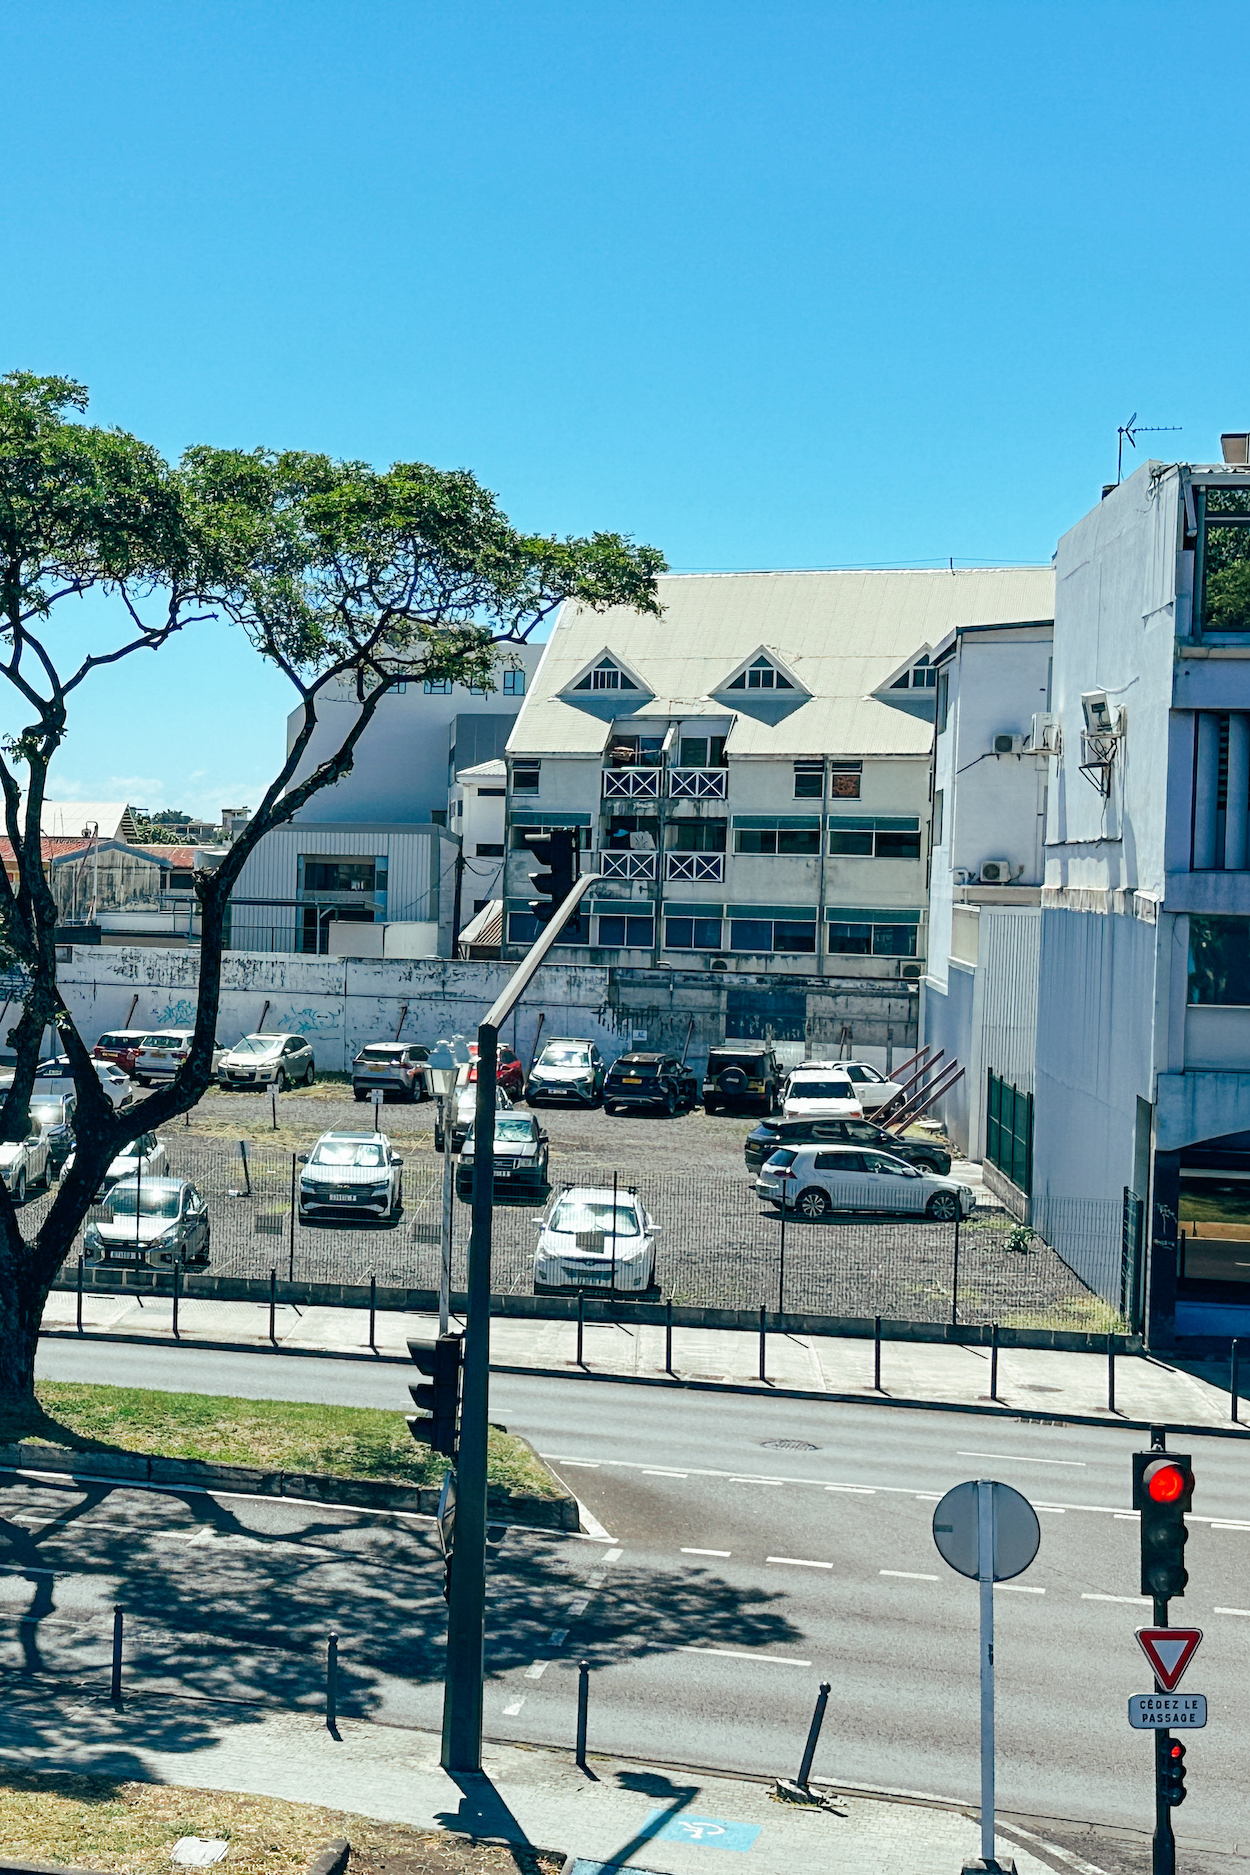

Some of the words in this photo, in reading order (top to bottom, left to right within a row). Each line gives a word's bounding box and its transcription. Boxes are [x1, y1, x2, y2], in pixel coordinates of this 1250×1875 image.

[1139, 1698, 1179, 1710] CÉDEZ
[1184, 1700, 1198, 1710] LE
[1142, 1713, 1196, 1723] PASSAGE
